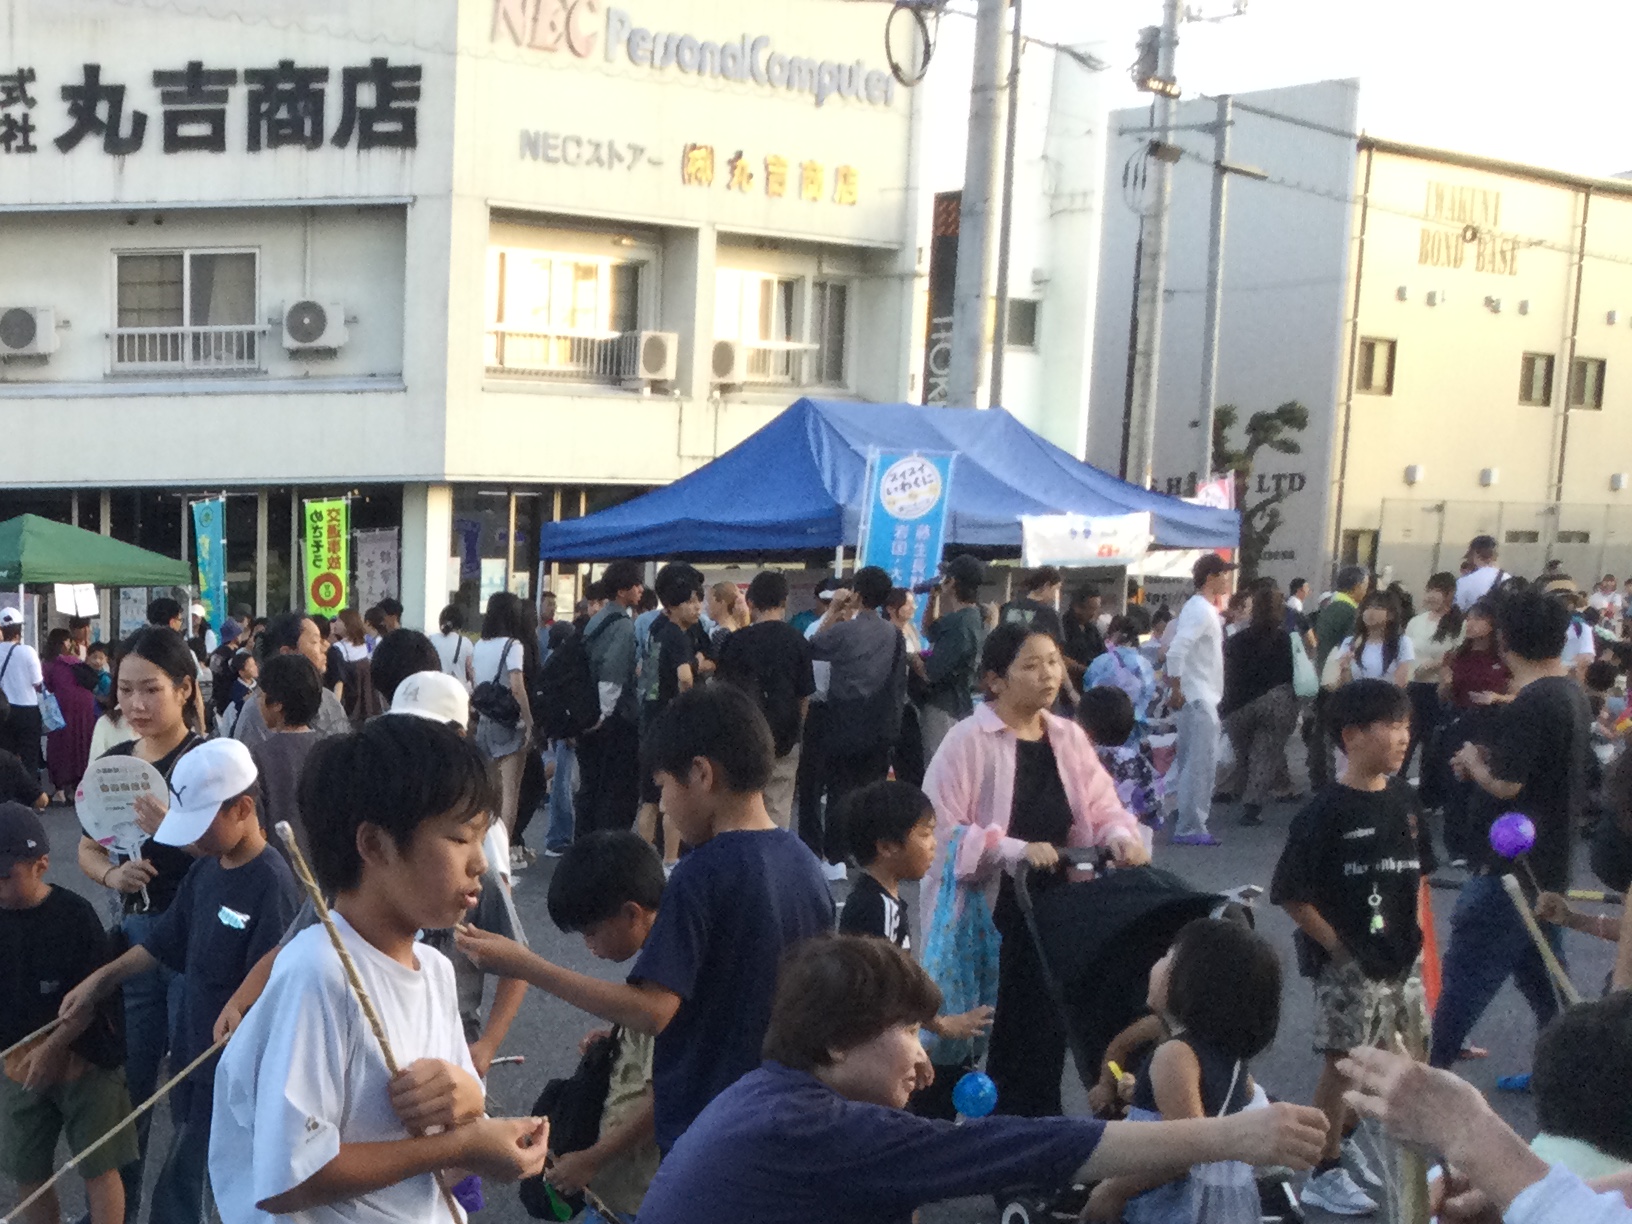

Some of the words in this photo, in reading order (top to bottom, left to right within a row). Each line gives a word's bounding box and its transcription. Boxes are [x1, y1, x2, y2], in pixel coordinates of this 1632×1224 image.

[491, 0, 597, 58] NEC
[53, 57, 423, 155] 丸吉商店
